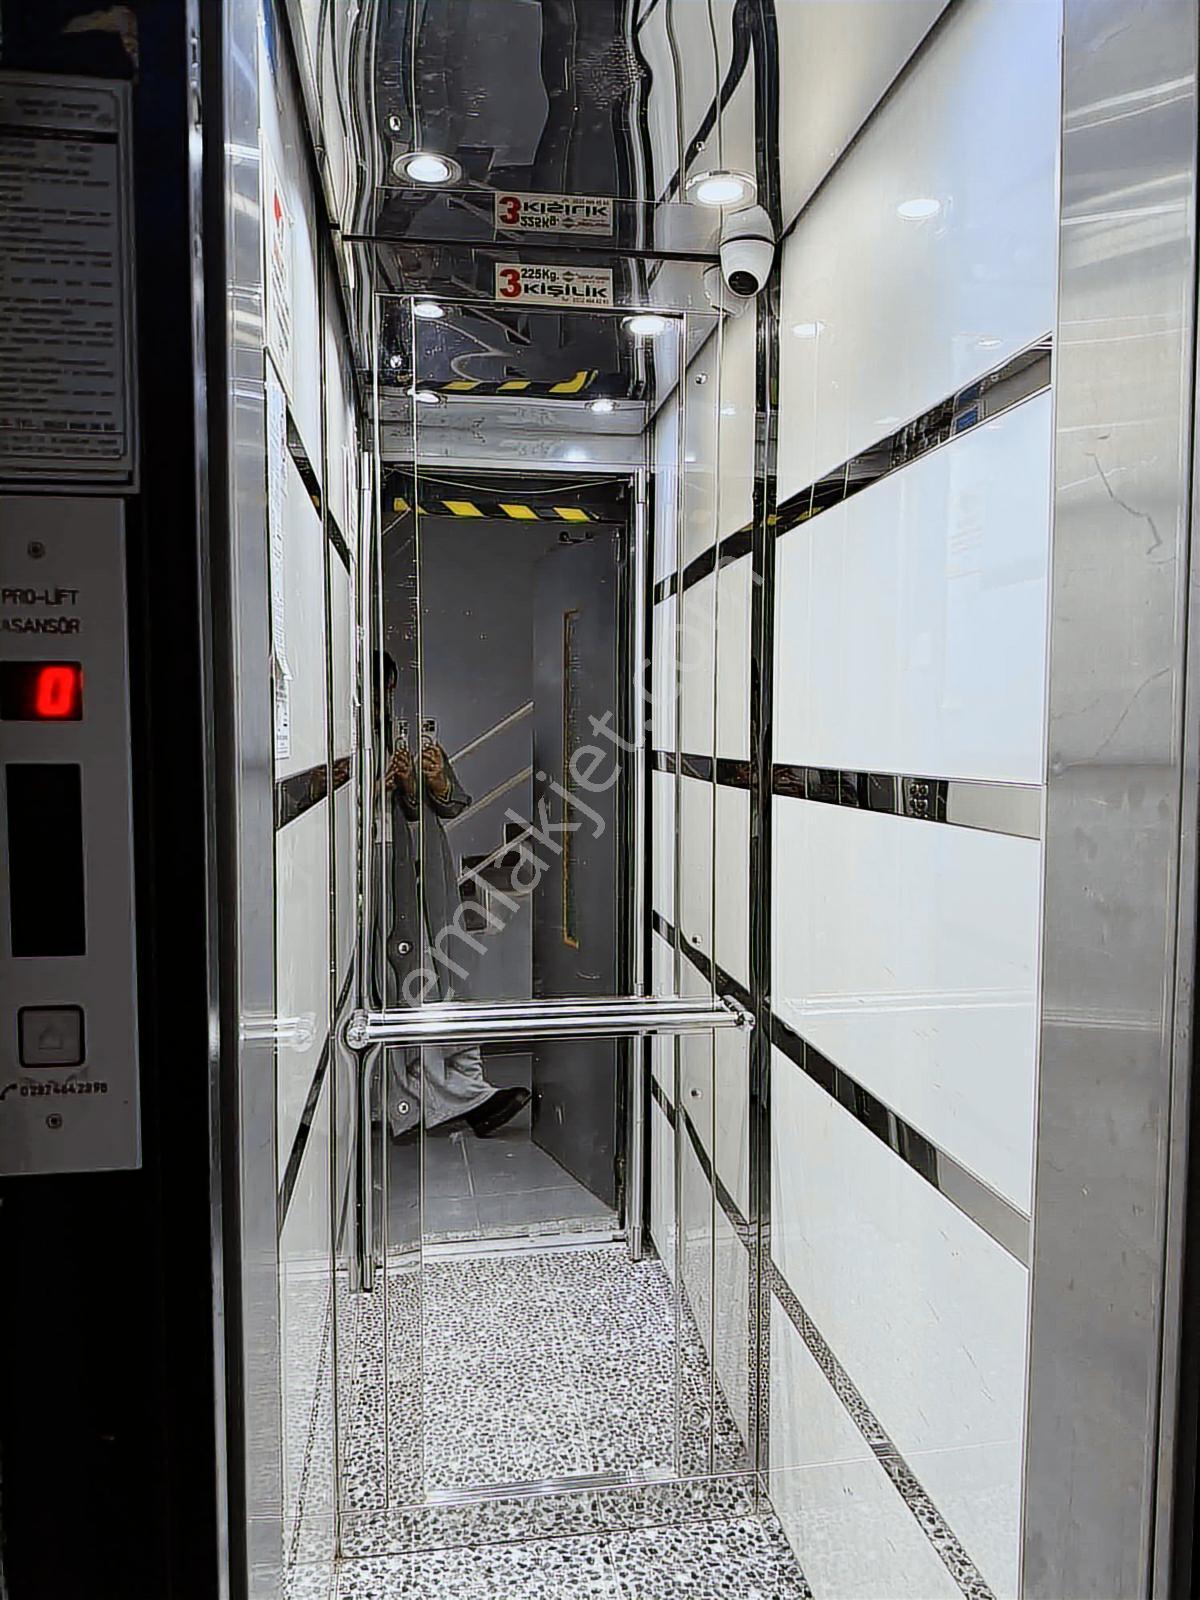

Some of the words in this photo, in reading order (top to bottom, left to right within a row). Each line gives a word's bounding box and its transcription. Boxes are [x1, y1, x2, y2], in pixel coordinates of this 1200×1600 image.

[500, 268, 522, 298] 3
[521, 268, 560, 282] 225Kg.
[2, 588, 79, 606] PRO-LIFT
[1, 616, 80, 635] ASANSÖR
[36, 665, 76, 718] 0
